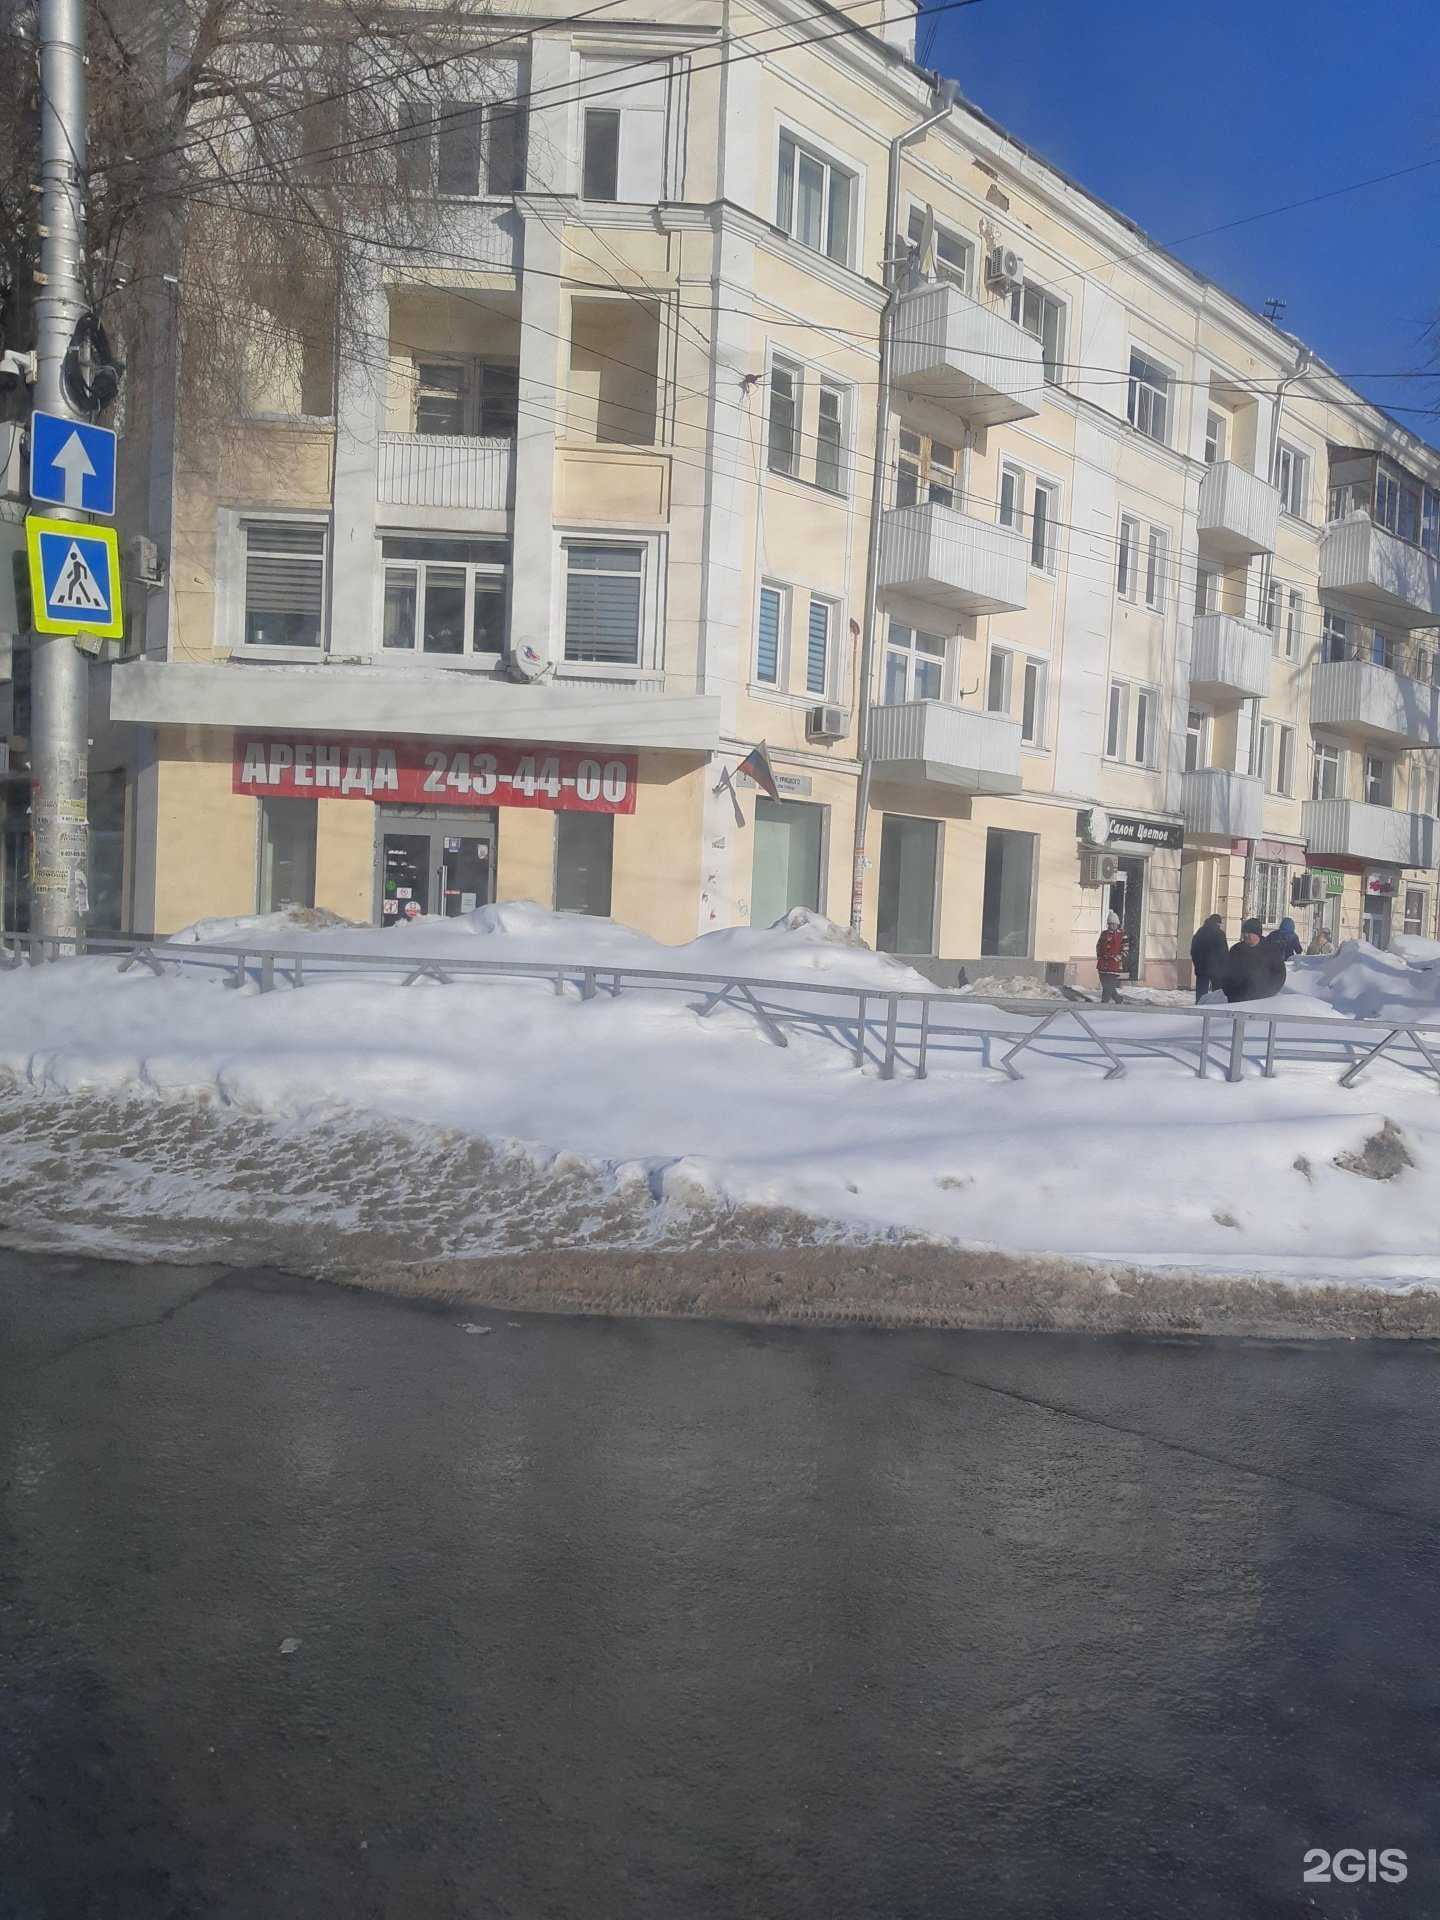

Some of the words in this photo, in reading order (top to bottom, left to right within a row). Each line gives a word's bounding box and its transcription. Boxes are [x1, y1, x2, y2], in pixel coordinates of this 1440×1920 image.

[241, 742, 399, 796] АРЕНДА
[423, 750, 627, 803] 243-44-00
[1109, 819, 1134, 837] Салон
[1137, 823, 1169, 842] Цветов
